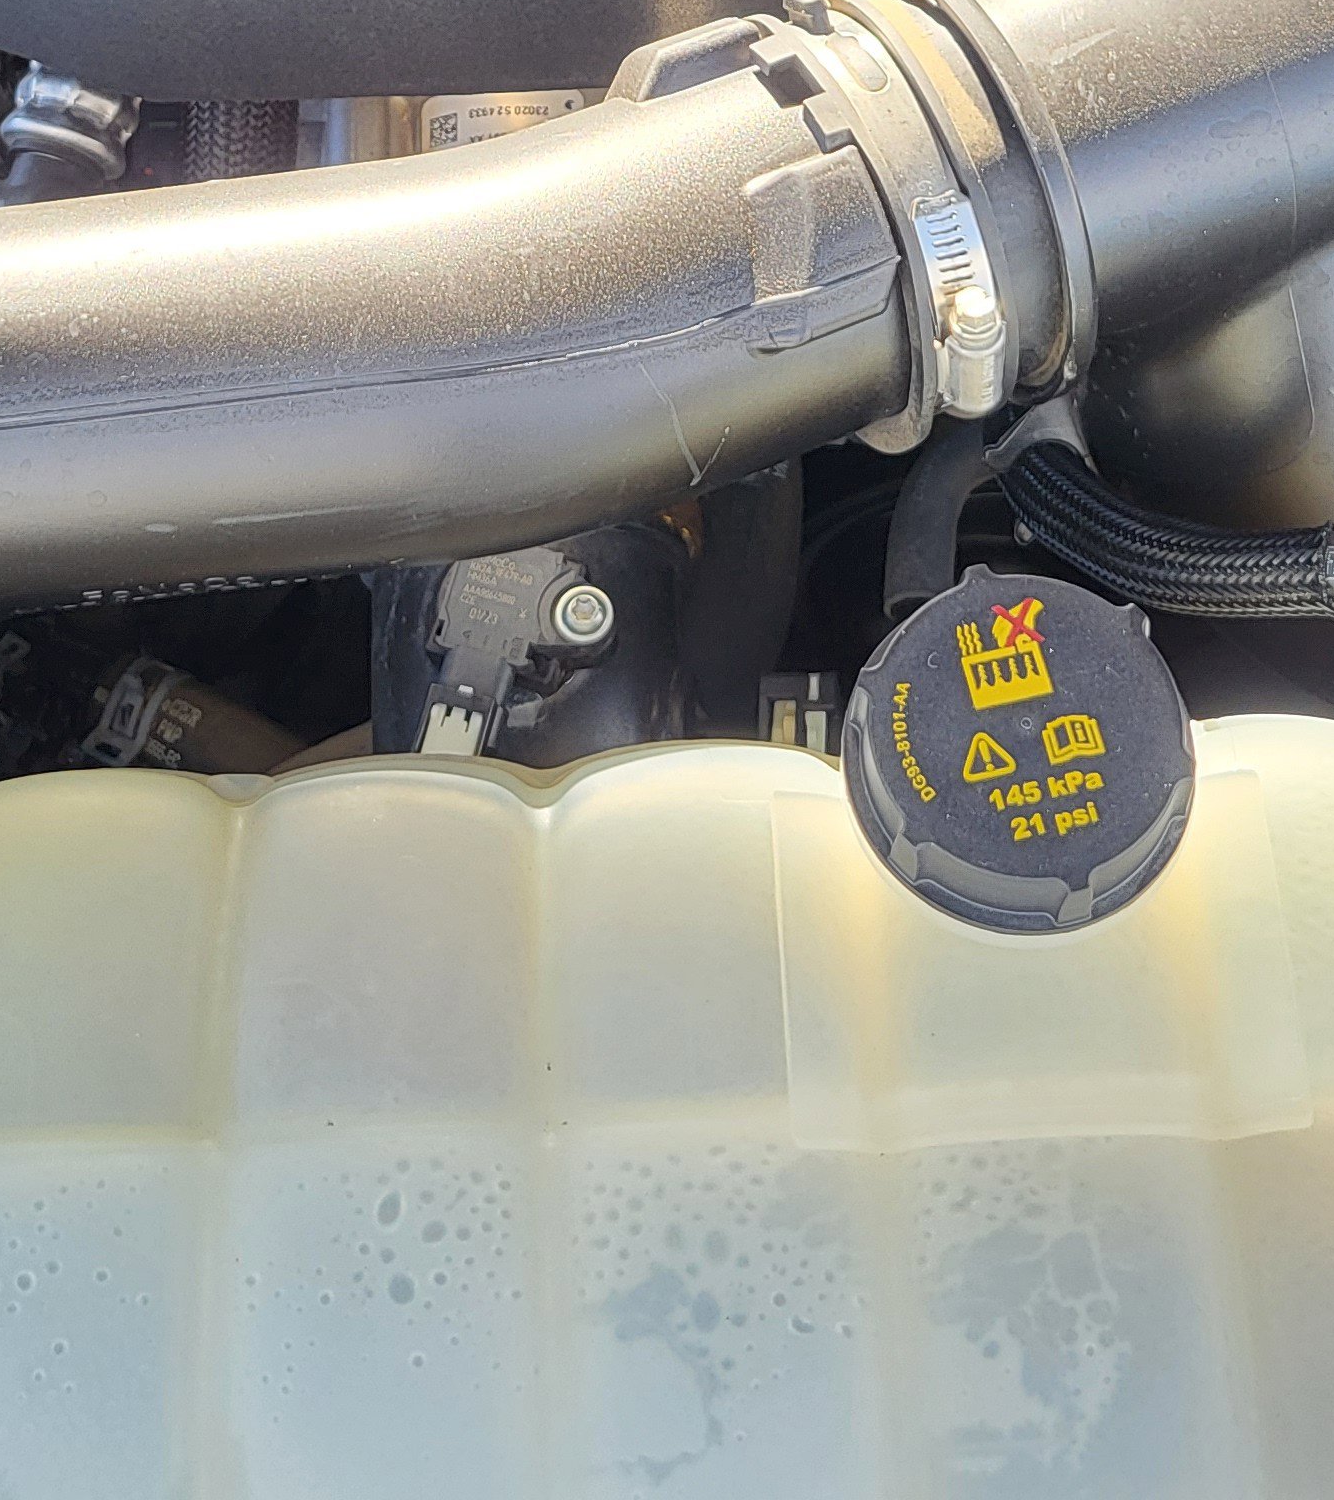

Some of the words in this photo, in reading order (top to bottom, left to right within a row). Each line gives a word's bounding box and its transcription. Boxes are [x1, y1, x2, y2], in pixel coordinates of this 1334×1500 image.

[893, 681, 937, 803] DG93-8101-AA
[988, 781, 1042, 812] 145
[1047, 770, 1105, 799] kPa
[1010, 813, 1046, 842] 21
[1054, 801, 1100, 836] psi
